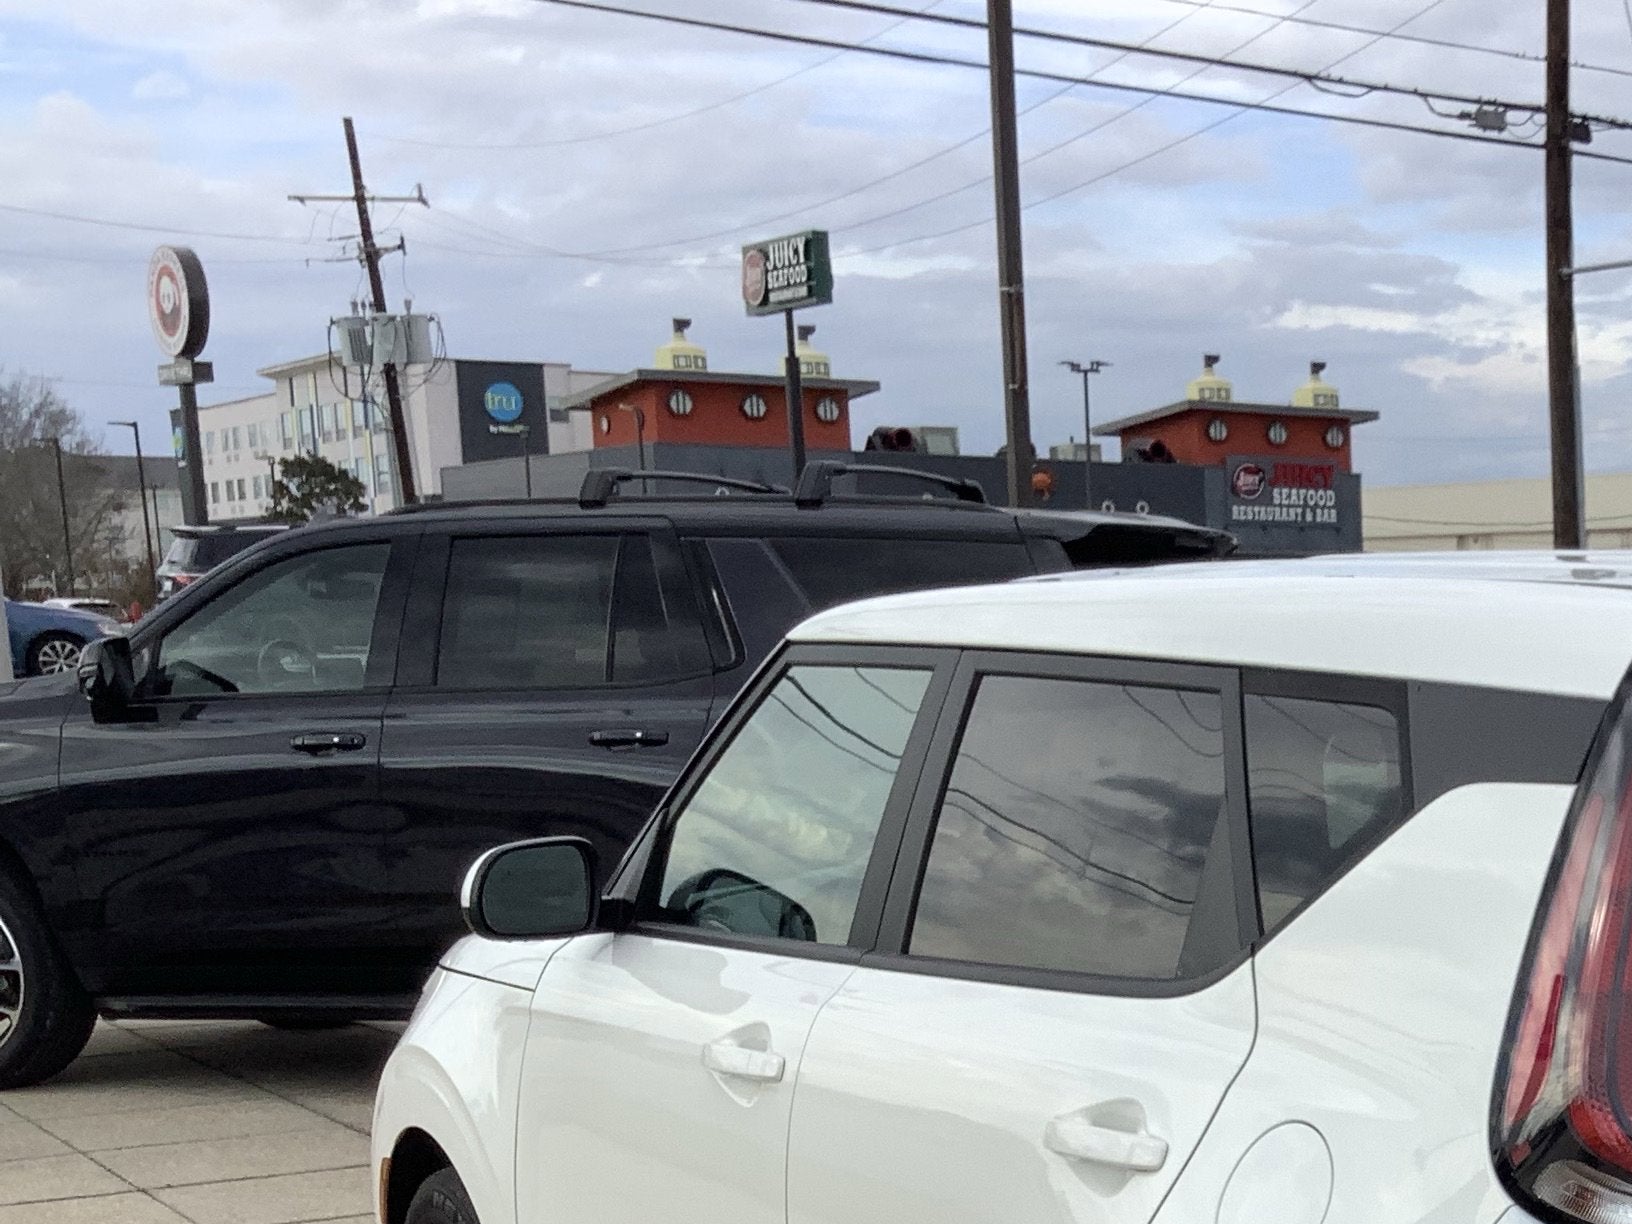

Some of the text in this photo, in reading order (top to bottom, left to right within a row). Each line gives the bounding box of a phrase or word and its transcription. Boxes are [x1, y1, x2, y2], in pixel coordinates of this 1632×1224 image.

[766, 236, 805, 271] JUICY
[767, 263, 808, 290] SEAFOOD
[485, 391, 516, 411] tru
[1273, 487, 1336, 507] SEAFOOD
[1231, 504, 1303, 522] RESTAURANT
[1316, 508, 1338, 523] BAR
